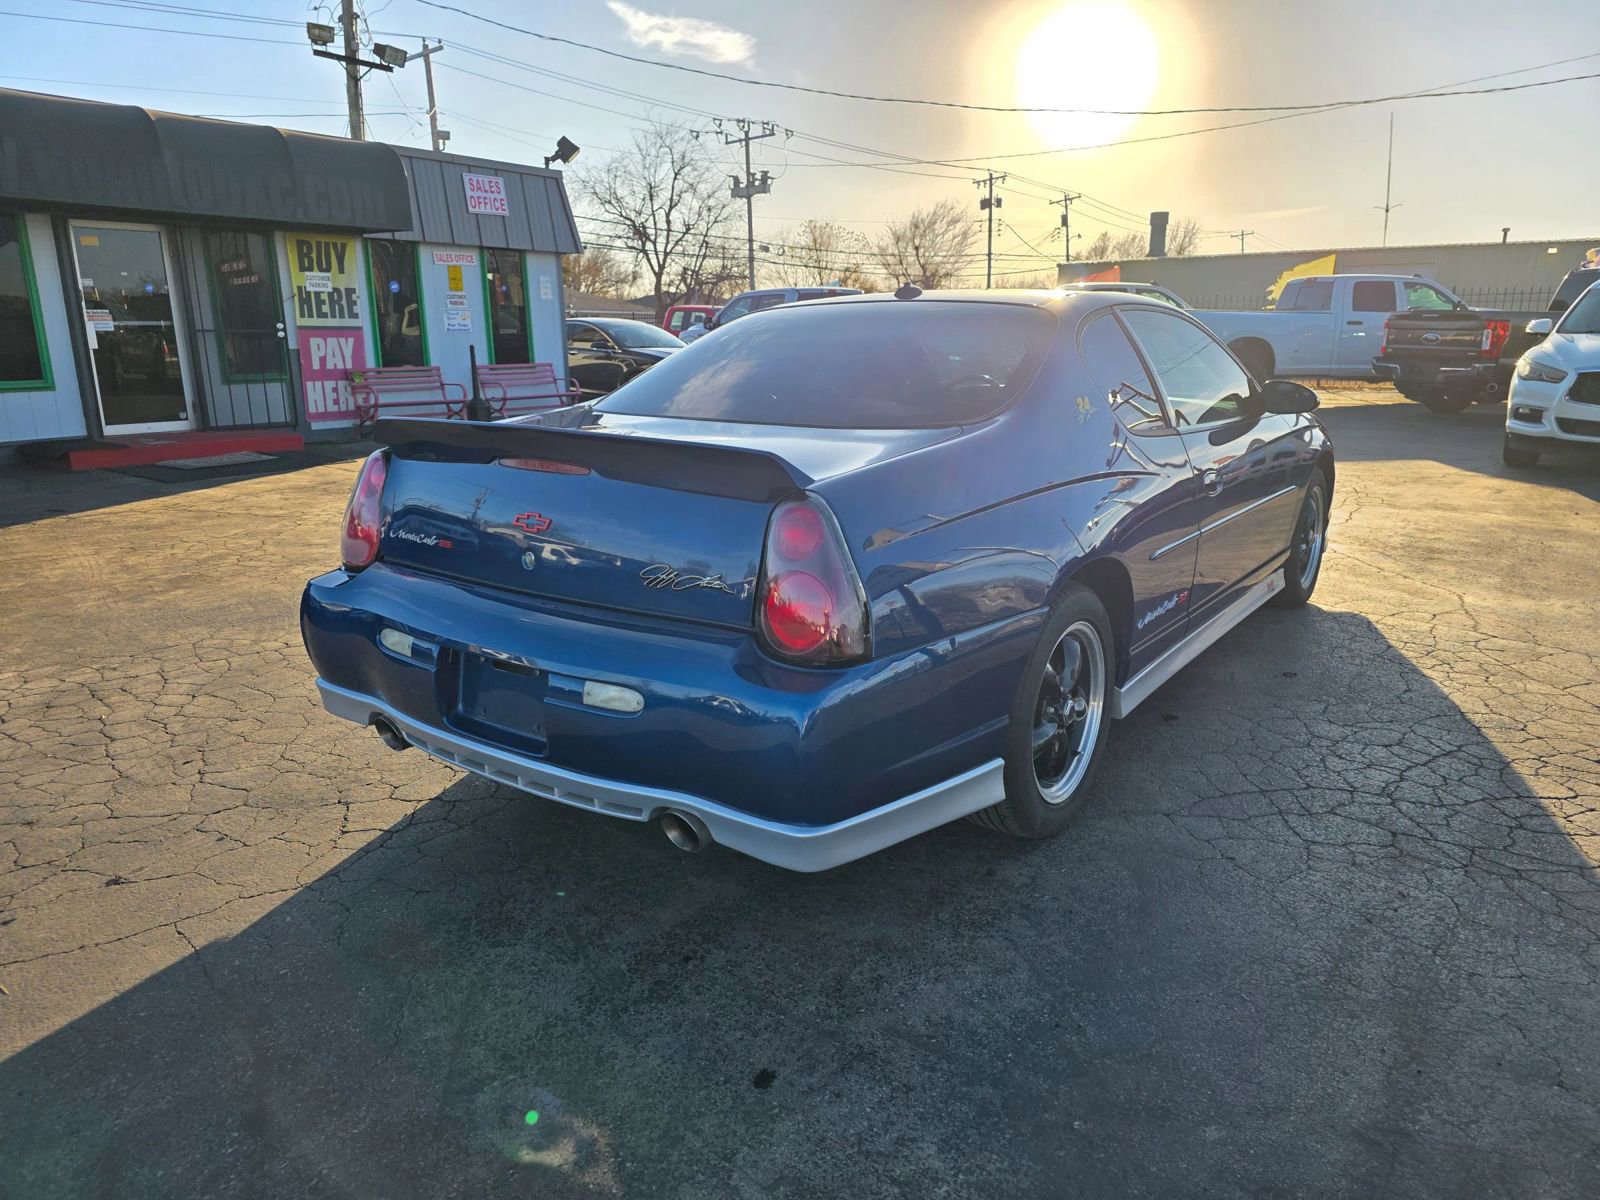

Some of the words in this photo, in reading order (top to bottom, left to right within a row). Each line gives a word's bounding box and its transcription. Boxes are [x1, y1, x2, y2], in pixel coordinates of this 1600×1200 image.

[468, 176, 501, 195] SALES
[470, 195, 506, 212] OFFICE
[295, 239, 347, 274] BUY
[435, 253, 453, 263] SALES
[455, 254, 475, 264] OFFICE
[296, 285, 360, 320] HERE
[309, 337, 354, 369] PAY
